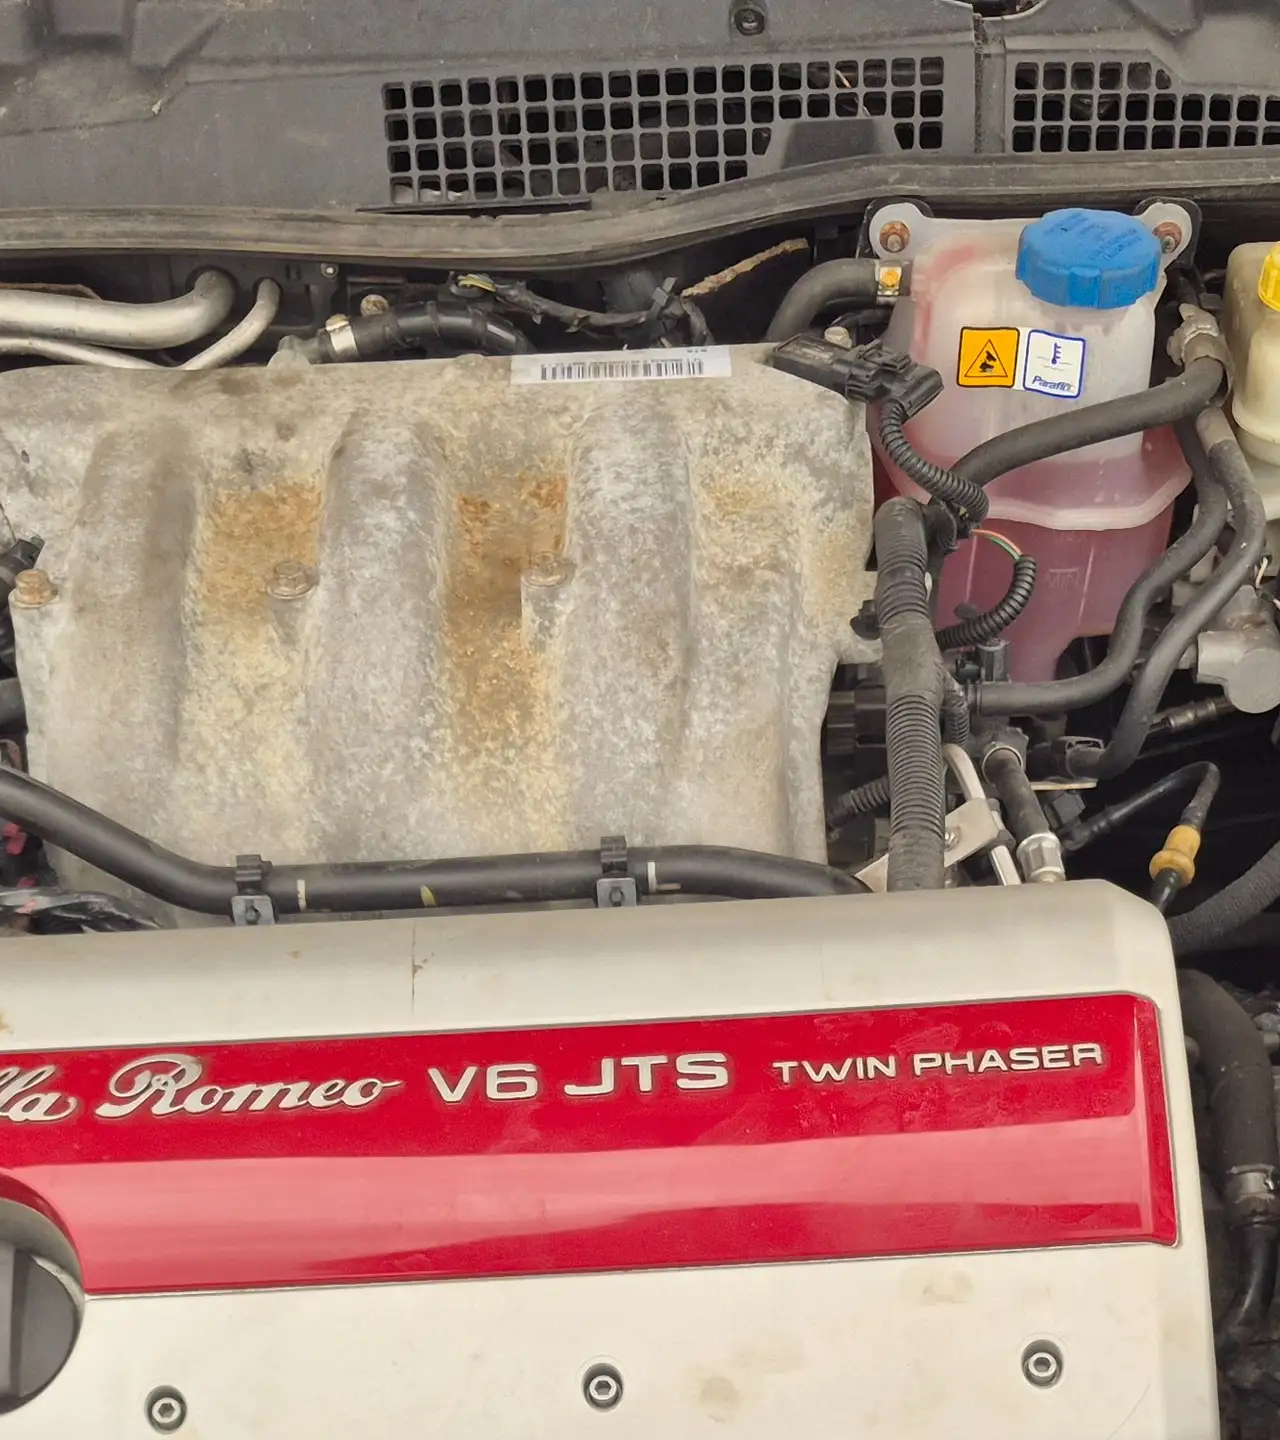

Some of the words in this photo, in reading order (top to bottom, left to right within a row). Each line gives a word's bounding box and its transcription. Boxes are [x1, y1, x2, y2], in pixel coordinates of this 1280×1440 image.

[95, 1053, 405, 1118] Romeo
[428, 1062, 540, 1103] V6
[564, 1052, 730, 1098] JTS
[772, 1057, 898, 1083] TWIN
[912, 1043, 1104, 1077] PHASER
